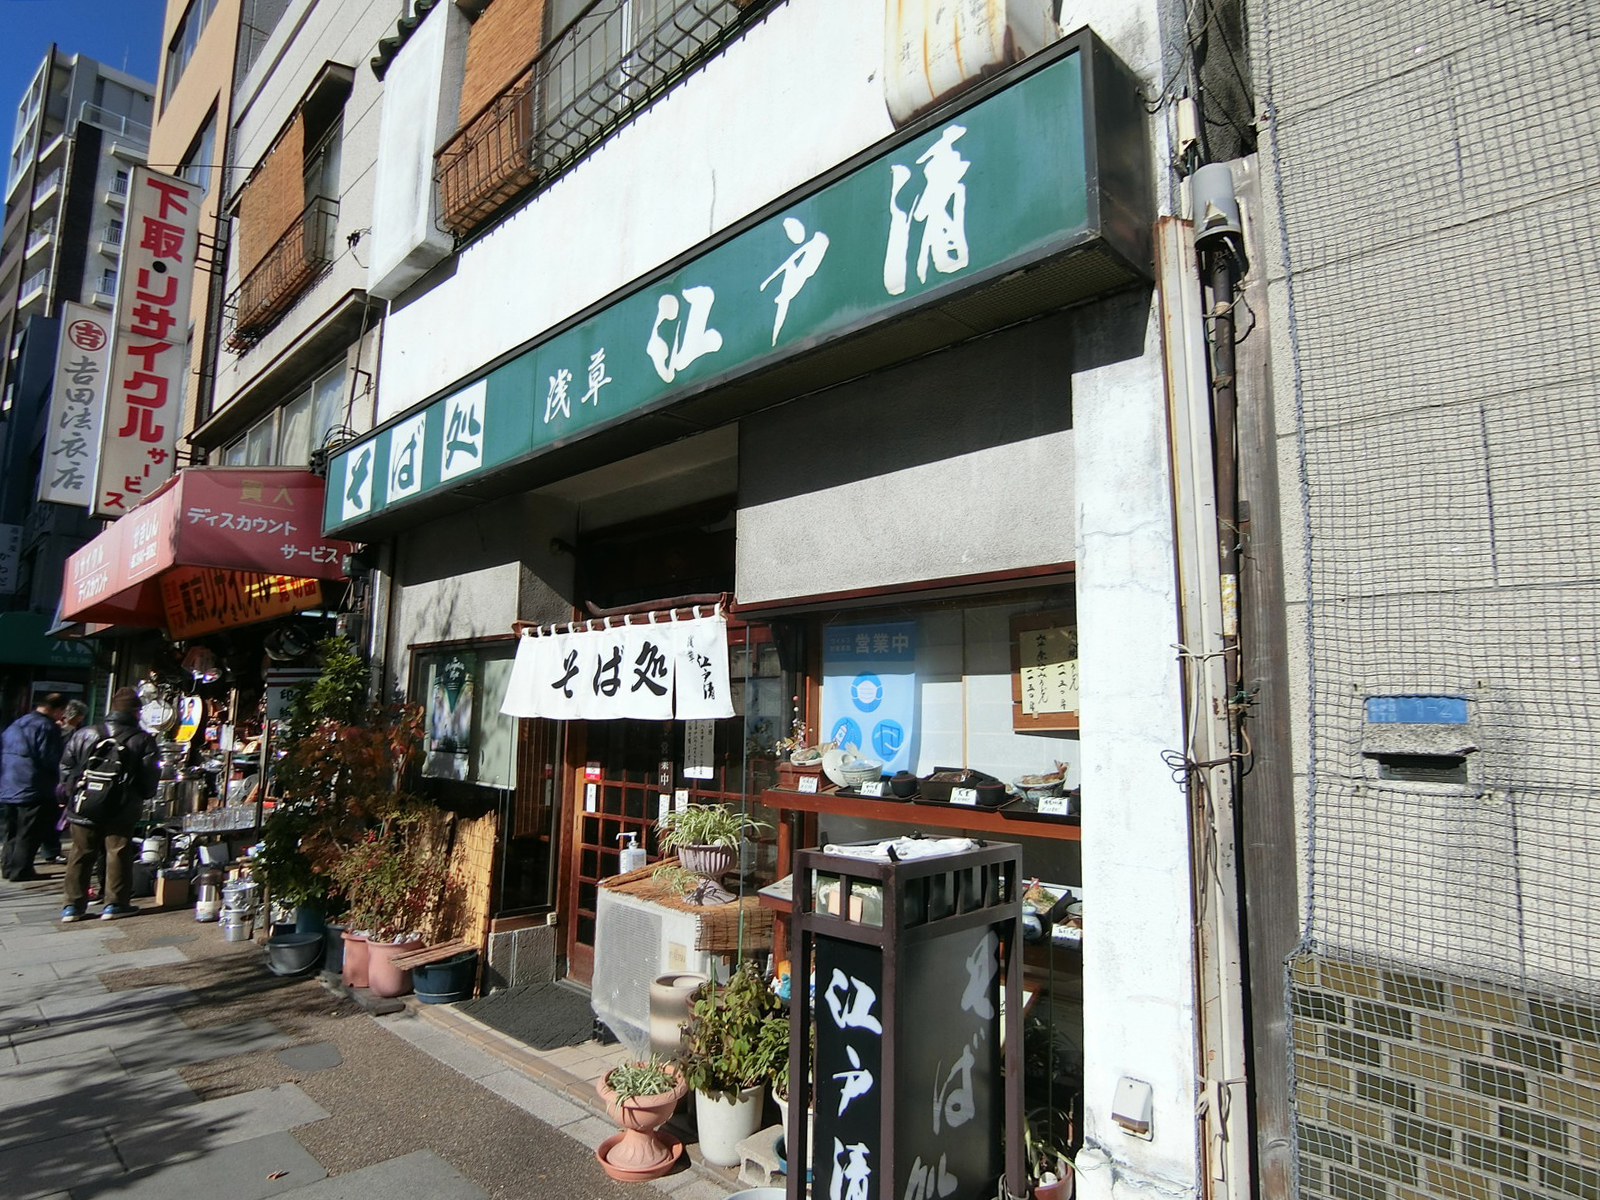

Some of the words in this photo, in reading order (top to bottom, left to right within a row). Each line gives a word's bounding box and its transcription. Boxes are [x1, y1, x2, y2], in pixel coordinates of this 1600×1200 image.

[646, 124, 971, 383] 江戸清
[543, 348, 613, 425] 浅草
[51, 355, 100, 490] 吉田法衣店
[103, 448, 168, 508] サービス
[346, 401, 481, 510] そば処
[187, 507, 297, 536] ディスカウント
[74, 544, 104, 580] リサイクル
[280, 544, 339, 564] サービス
[77, 571, 108, 603] ディスカウント
[551, 640, 668, 699] そば処
[855, 632, 909, 654] 営業中
[696, 653, 716, 700] 江戸清
